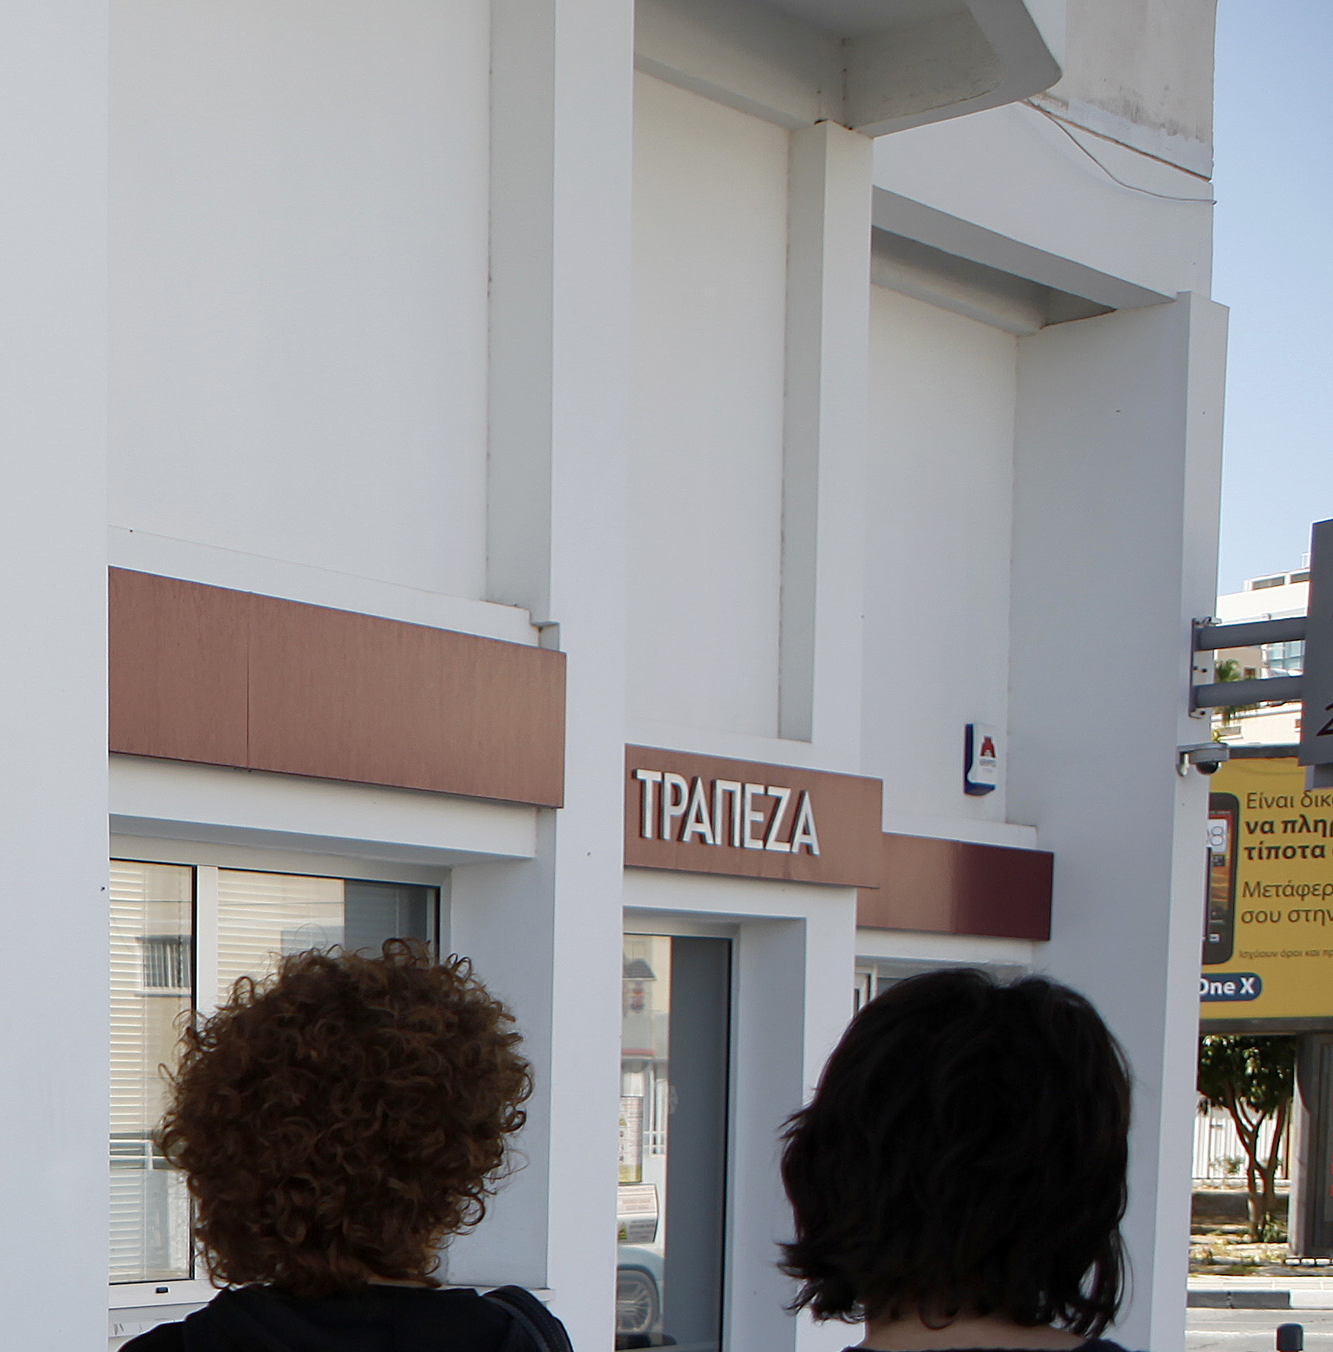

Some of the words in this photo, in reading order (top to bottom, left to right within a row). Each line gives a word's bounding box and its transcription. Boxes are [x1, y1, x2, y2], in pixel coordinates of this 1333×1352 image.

[1245, 791, 1295, 810] Είναι
[1300, 790, 1333, 808] δικ
[632, 768, 821, 856] ΤΡΑΠΕΖΑ
[1244, 819, 1275, 835] να
[1281, 813, 1333, 838] πλη
[1244, 840, 1326, 861] τίποτα
[1240, 909, 1281, 924] σου
[1199, 978, 1236, 996] One
[1239, 976, 1255, 995] X
